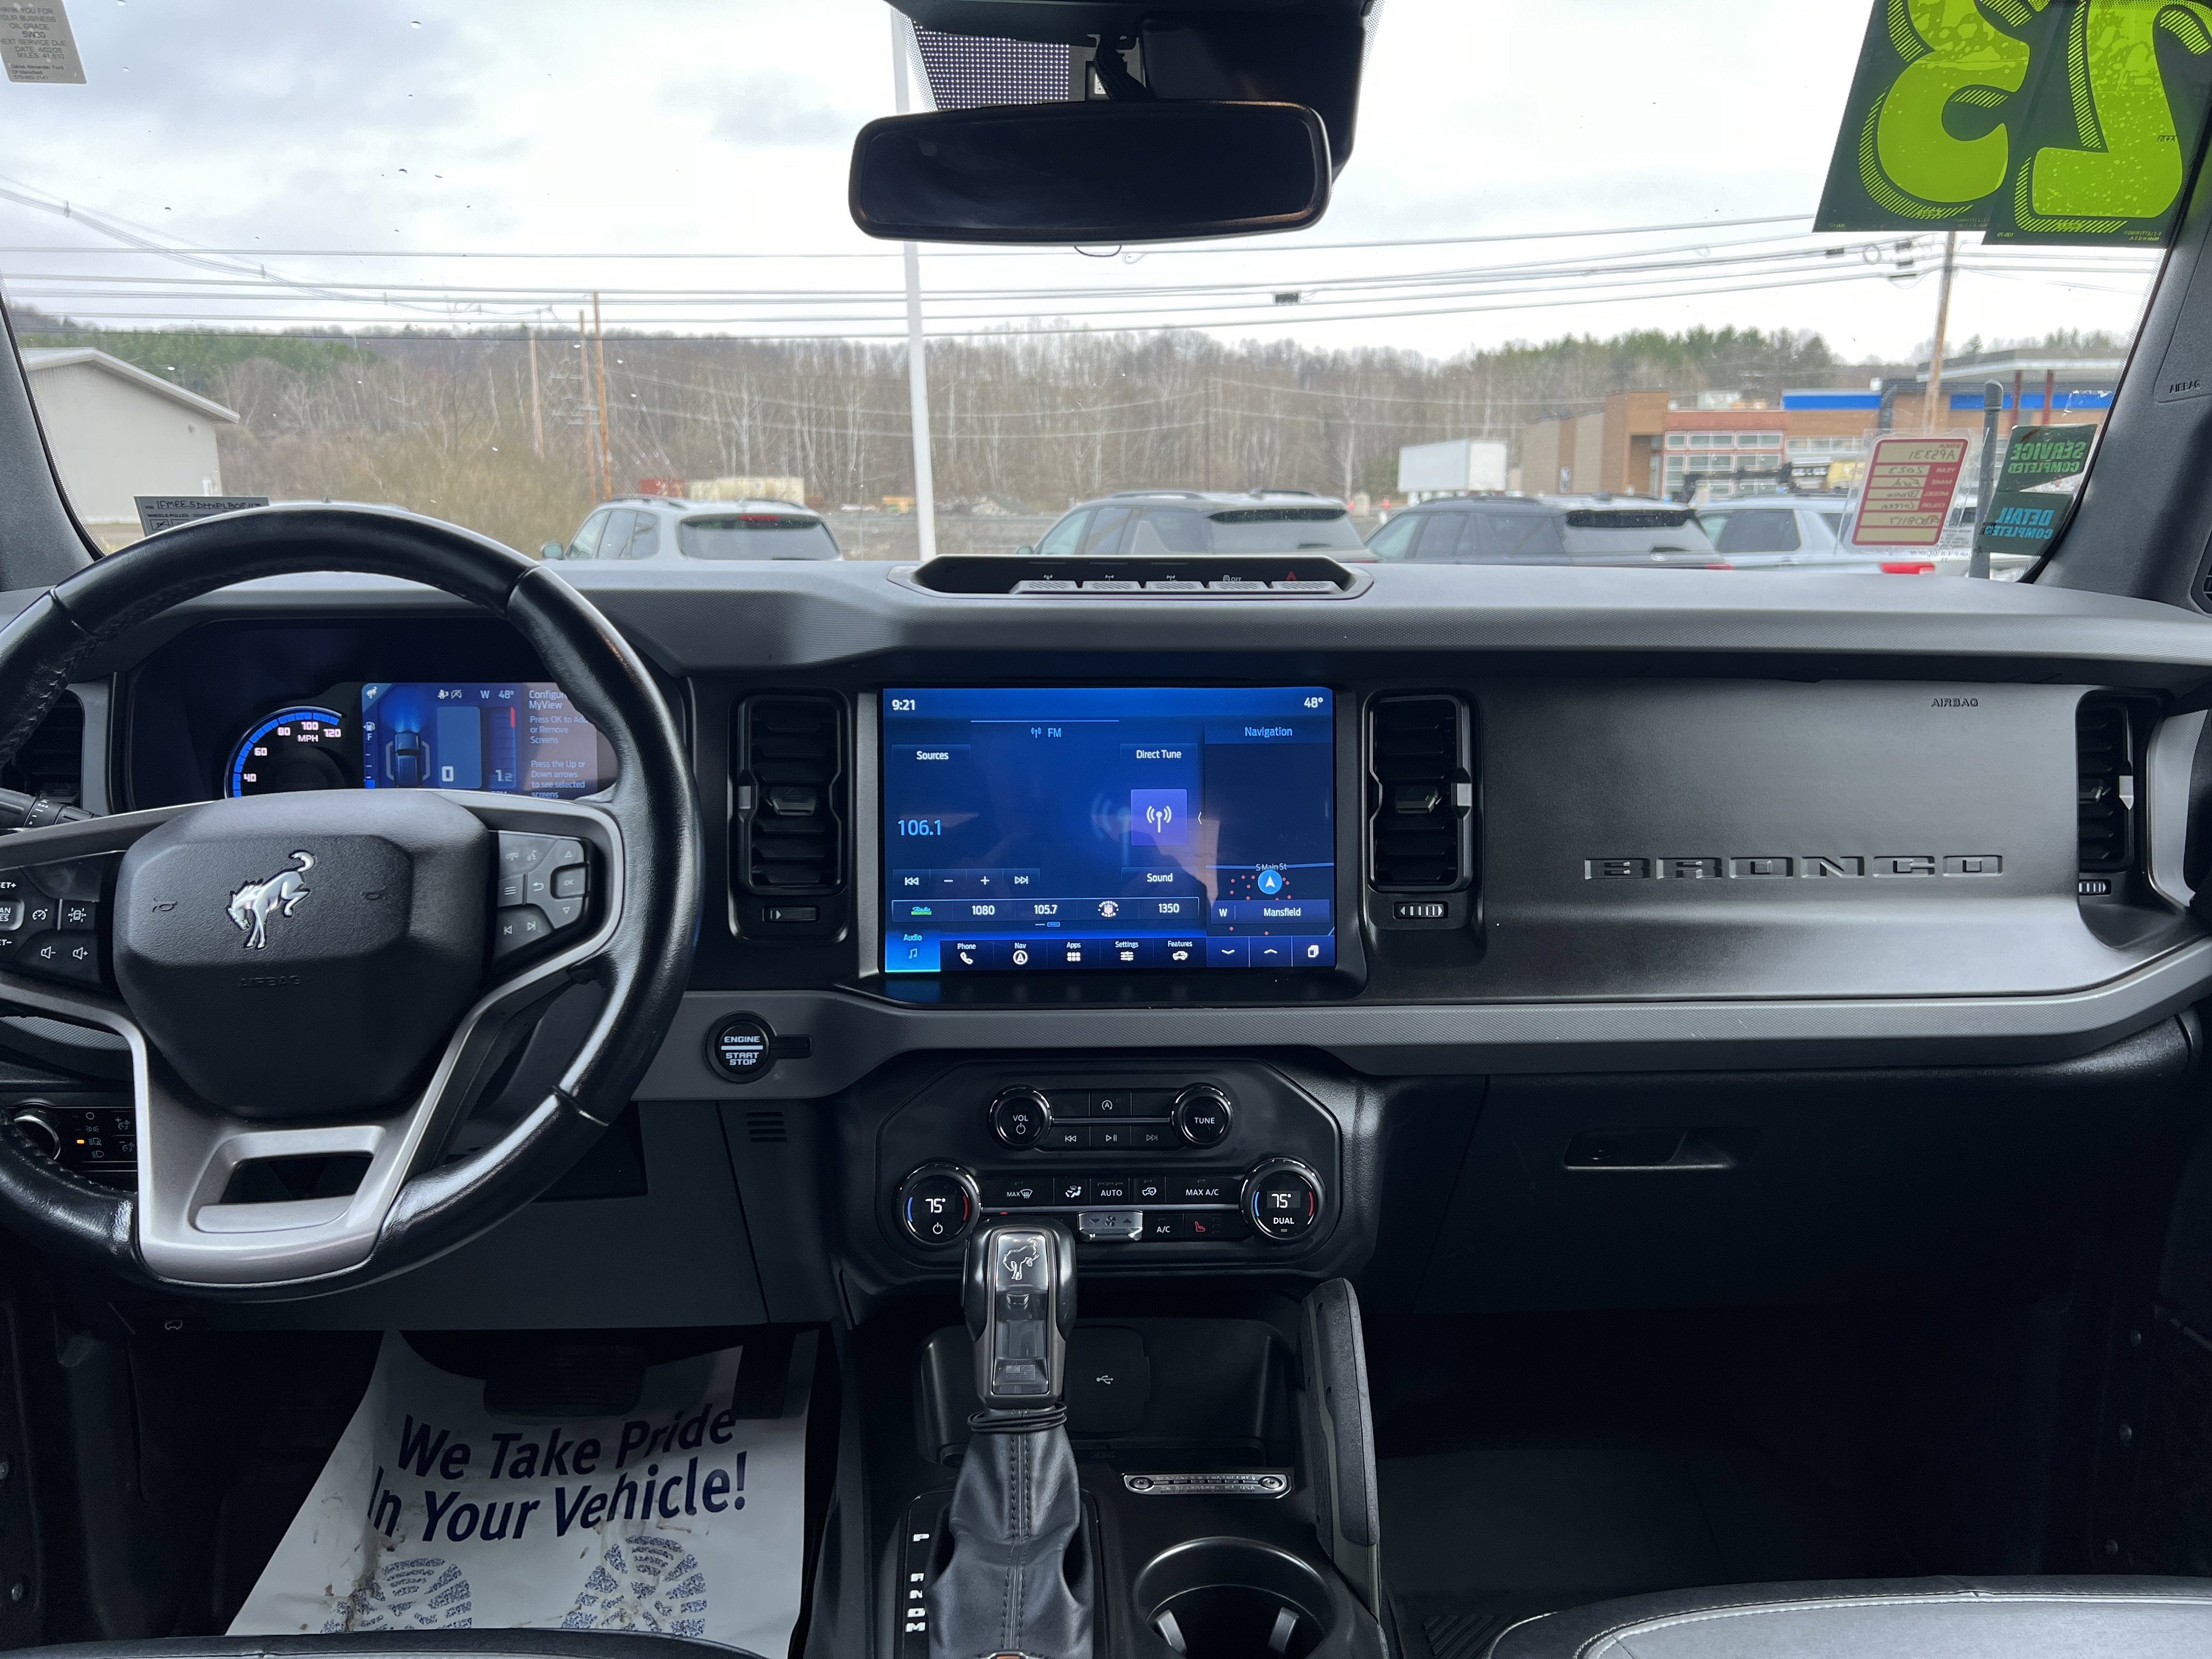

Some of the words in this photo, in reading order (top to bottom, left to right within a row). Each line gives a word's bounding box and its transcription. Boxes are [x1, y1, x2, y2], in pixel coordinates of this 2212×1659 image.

[480, 690, 490, 699] W
[498, 690, 515, 699] 48°
[528, 701, 563, 710] MyView
[891, 699, 916, 710] 9:21
[1304, 697, 1324, 708] 48°
[1931, 698, 1978, 707] AIRBAG
[301, 721, 319, 730] 100
[540, 725, 569, 733] Remove
[278, 727, 291, 736] 80
[323, 729, 341, 737] 120
[1047, 727, 1062, 737] FM
[1244, 727, 1293, 738] Navigation
[530, 736, 558, 744] Screens
[254, 747, 268, 757] 60
[916, 751, 949, 760] Sources
[1136, 749, 1160, 759] Direct
[1161, 749, 1182, 759] Tune
[566, 760, 577, 770] Up
[243, 774, 257, 782] 40
[442, 766, 454, 782] 0
[898, 819, 942, 836] 106.1
[1584, 856, 2004, 879] BRONCO
[1147, 872, 1173, 882] Sound
[972, 905, 995, 915] 1080
[1034, 904, 1058, 915] 105.7
[1158, 903, 1180, 913] 1350
[1218, 908, 1228, 917] W
[1263, 907, 1301, 917] Mansfield
[1066, 941, 1081, 950] Apps
[1115, 940, 1138, 949] Settings
[1156, 1225, 1171, 1234] A/C
[398, 1413, 471, 1480] We
[490, 1427, 601, 1479] Take
[615, 1403, 737, 1469] Pride
[367, 1465, 402, 1538] In
[422, 1490, 541, 1542] Your
[555, 1451, 747, 1537] Vehicle!
[913, 1533, 929, 1542] P
[910, 1590, 923, 1599] N
[907, 1608, 926, 1617] D
[906, 1622, 926, 1632] M
